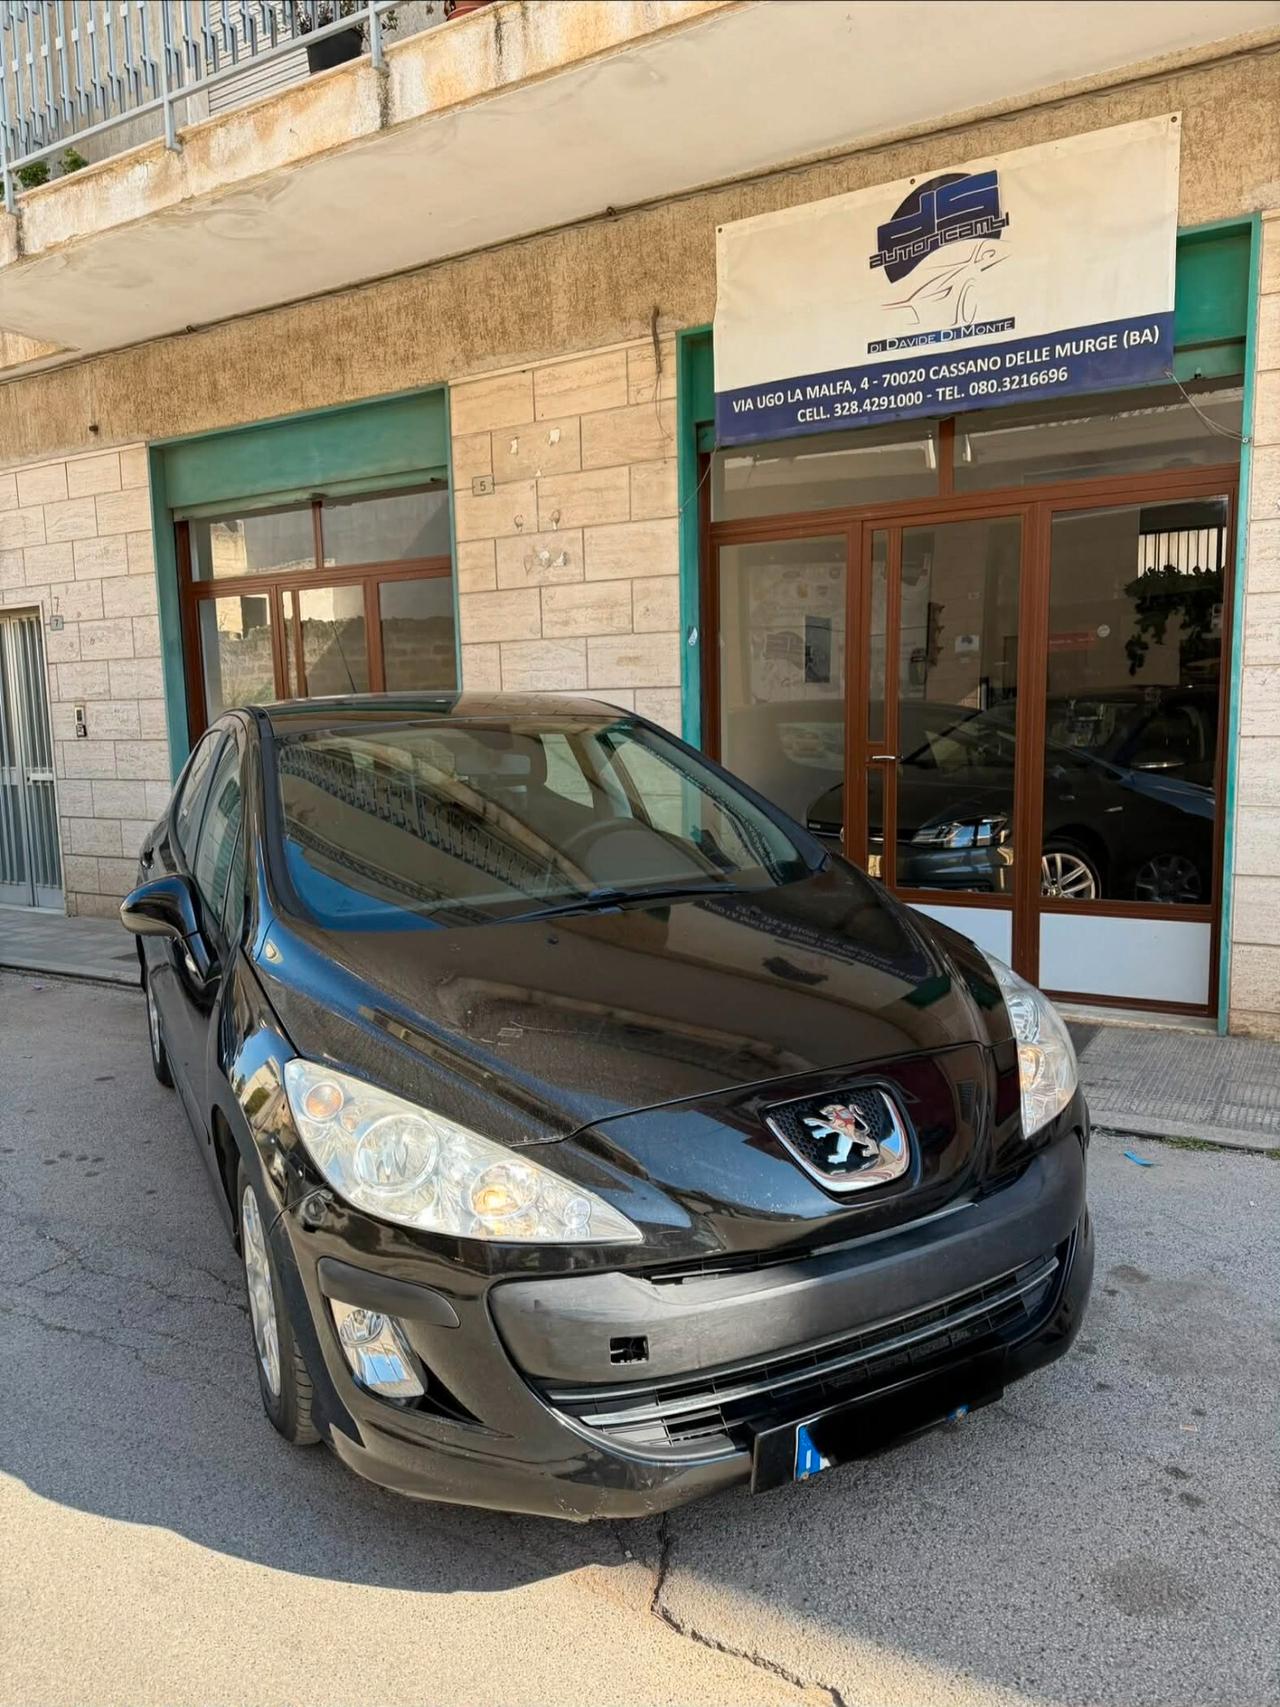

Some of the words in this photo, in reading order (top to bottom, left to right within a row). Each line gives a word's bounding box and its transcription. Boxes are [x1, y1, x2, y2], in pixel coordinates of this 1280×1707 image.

[886, 334, 936, 351] DAVIDE
[960, 320, 1013, 338] MONTE
[732, 397, 754, 413] VIA
[757, 391, 784, 409] UGO
[787, 388, 803, 403] LA
[806, 379, 857, 400] MALFA,
[860, 376, 870, 391] 4
[882, 368, 926, 388] 70020
[929, 356, 1001, 380] CASSANO
[1005, 346, 1051, 368] DELLE
[1055, 334, 1118, 359] MURGE
[1123, 324, 1160, 349] (BA)
[797, 405, 831, 423] CELL.
[833, 391, 923, 417] 328.4291000
[936, 385, 965, 401] TEL.
[969, 366, 1068, 396] 080.3216696
[479, 480, 487, 492] 5
